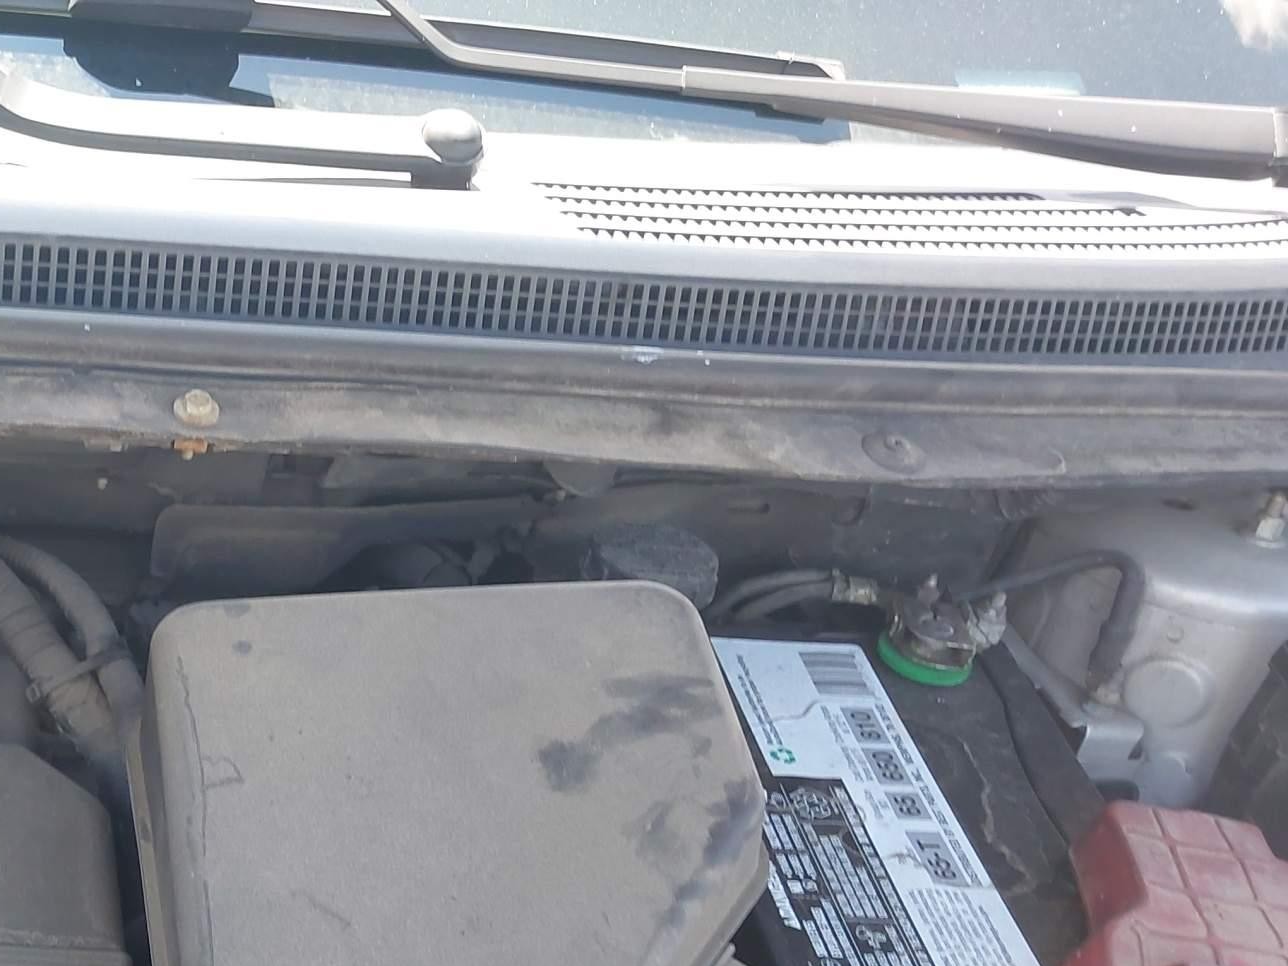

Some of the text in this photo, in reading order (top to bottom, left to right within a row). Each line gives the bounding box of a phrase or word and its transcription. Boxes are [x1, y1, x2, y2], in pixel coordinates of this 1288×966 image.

[868, 750, 905, 781] 650
[892, 796, 922, 815] 65
[917, 839, 957, 878] 65-T
